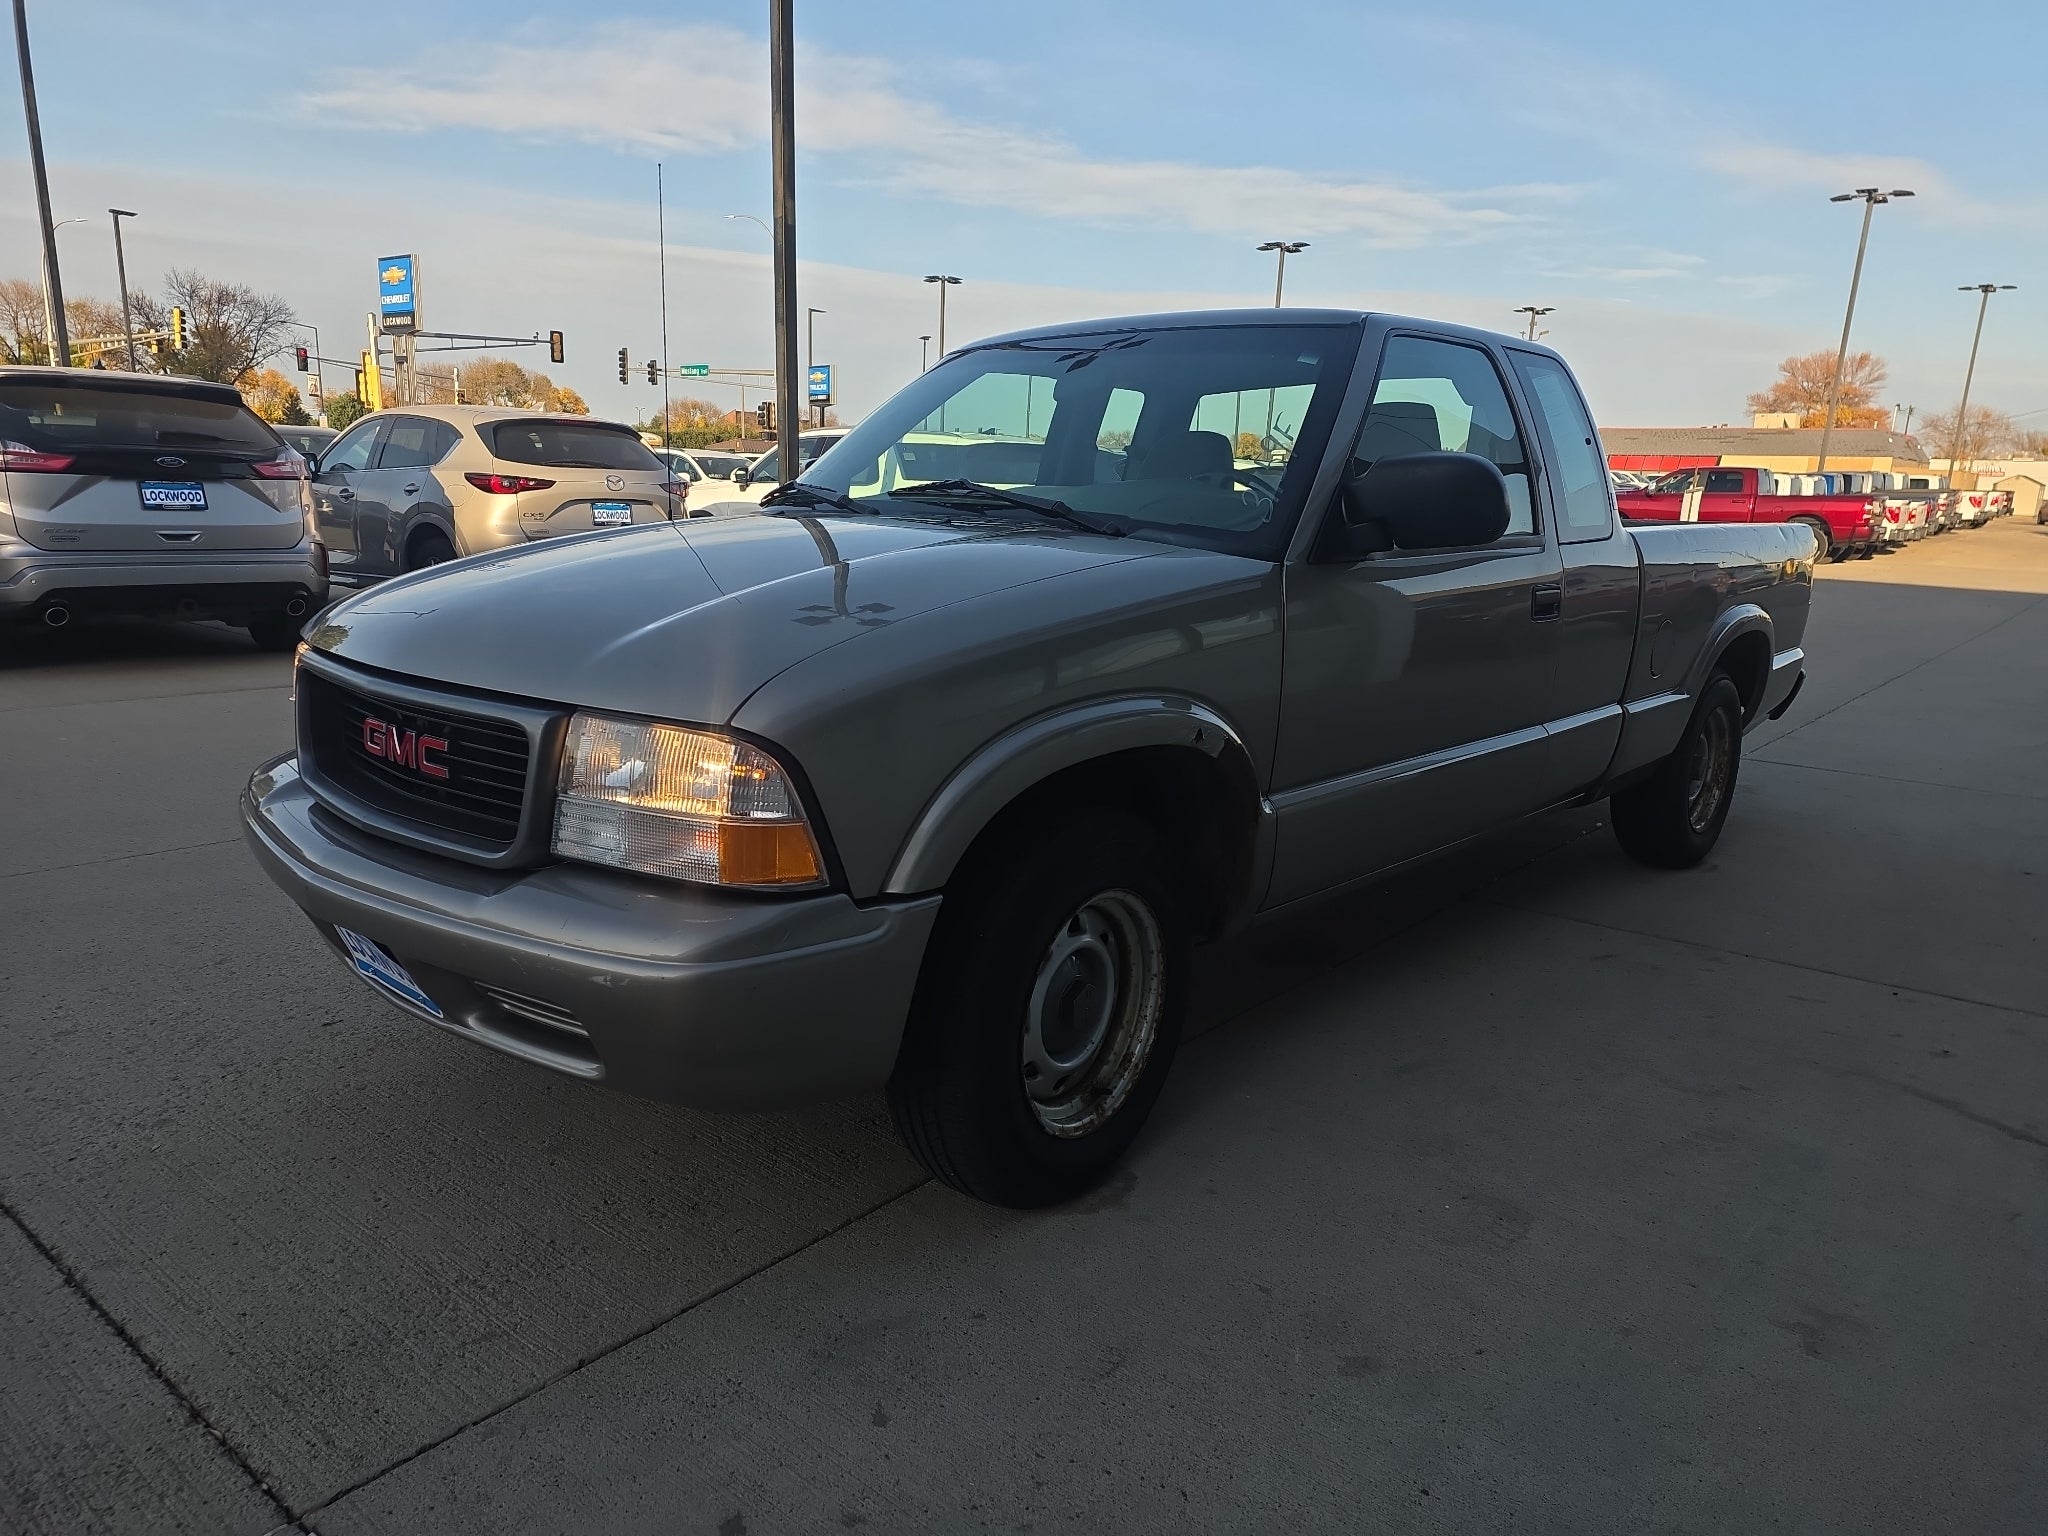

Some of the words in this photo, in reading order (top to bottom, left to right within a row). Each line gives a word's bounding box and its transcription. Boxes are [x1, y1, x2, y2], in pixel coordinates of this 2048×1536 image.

[381, 294, 410, 305] CHEVROLET
[383, 316, 411, 326] LOCKWOOD
[143, 490, 202, 502] LOCKWOOD
[594, 510, 629, 521] LOCKWOOD
[363, 717, 449, 779] GMC
